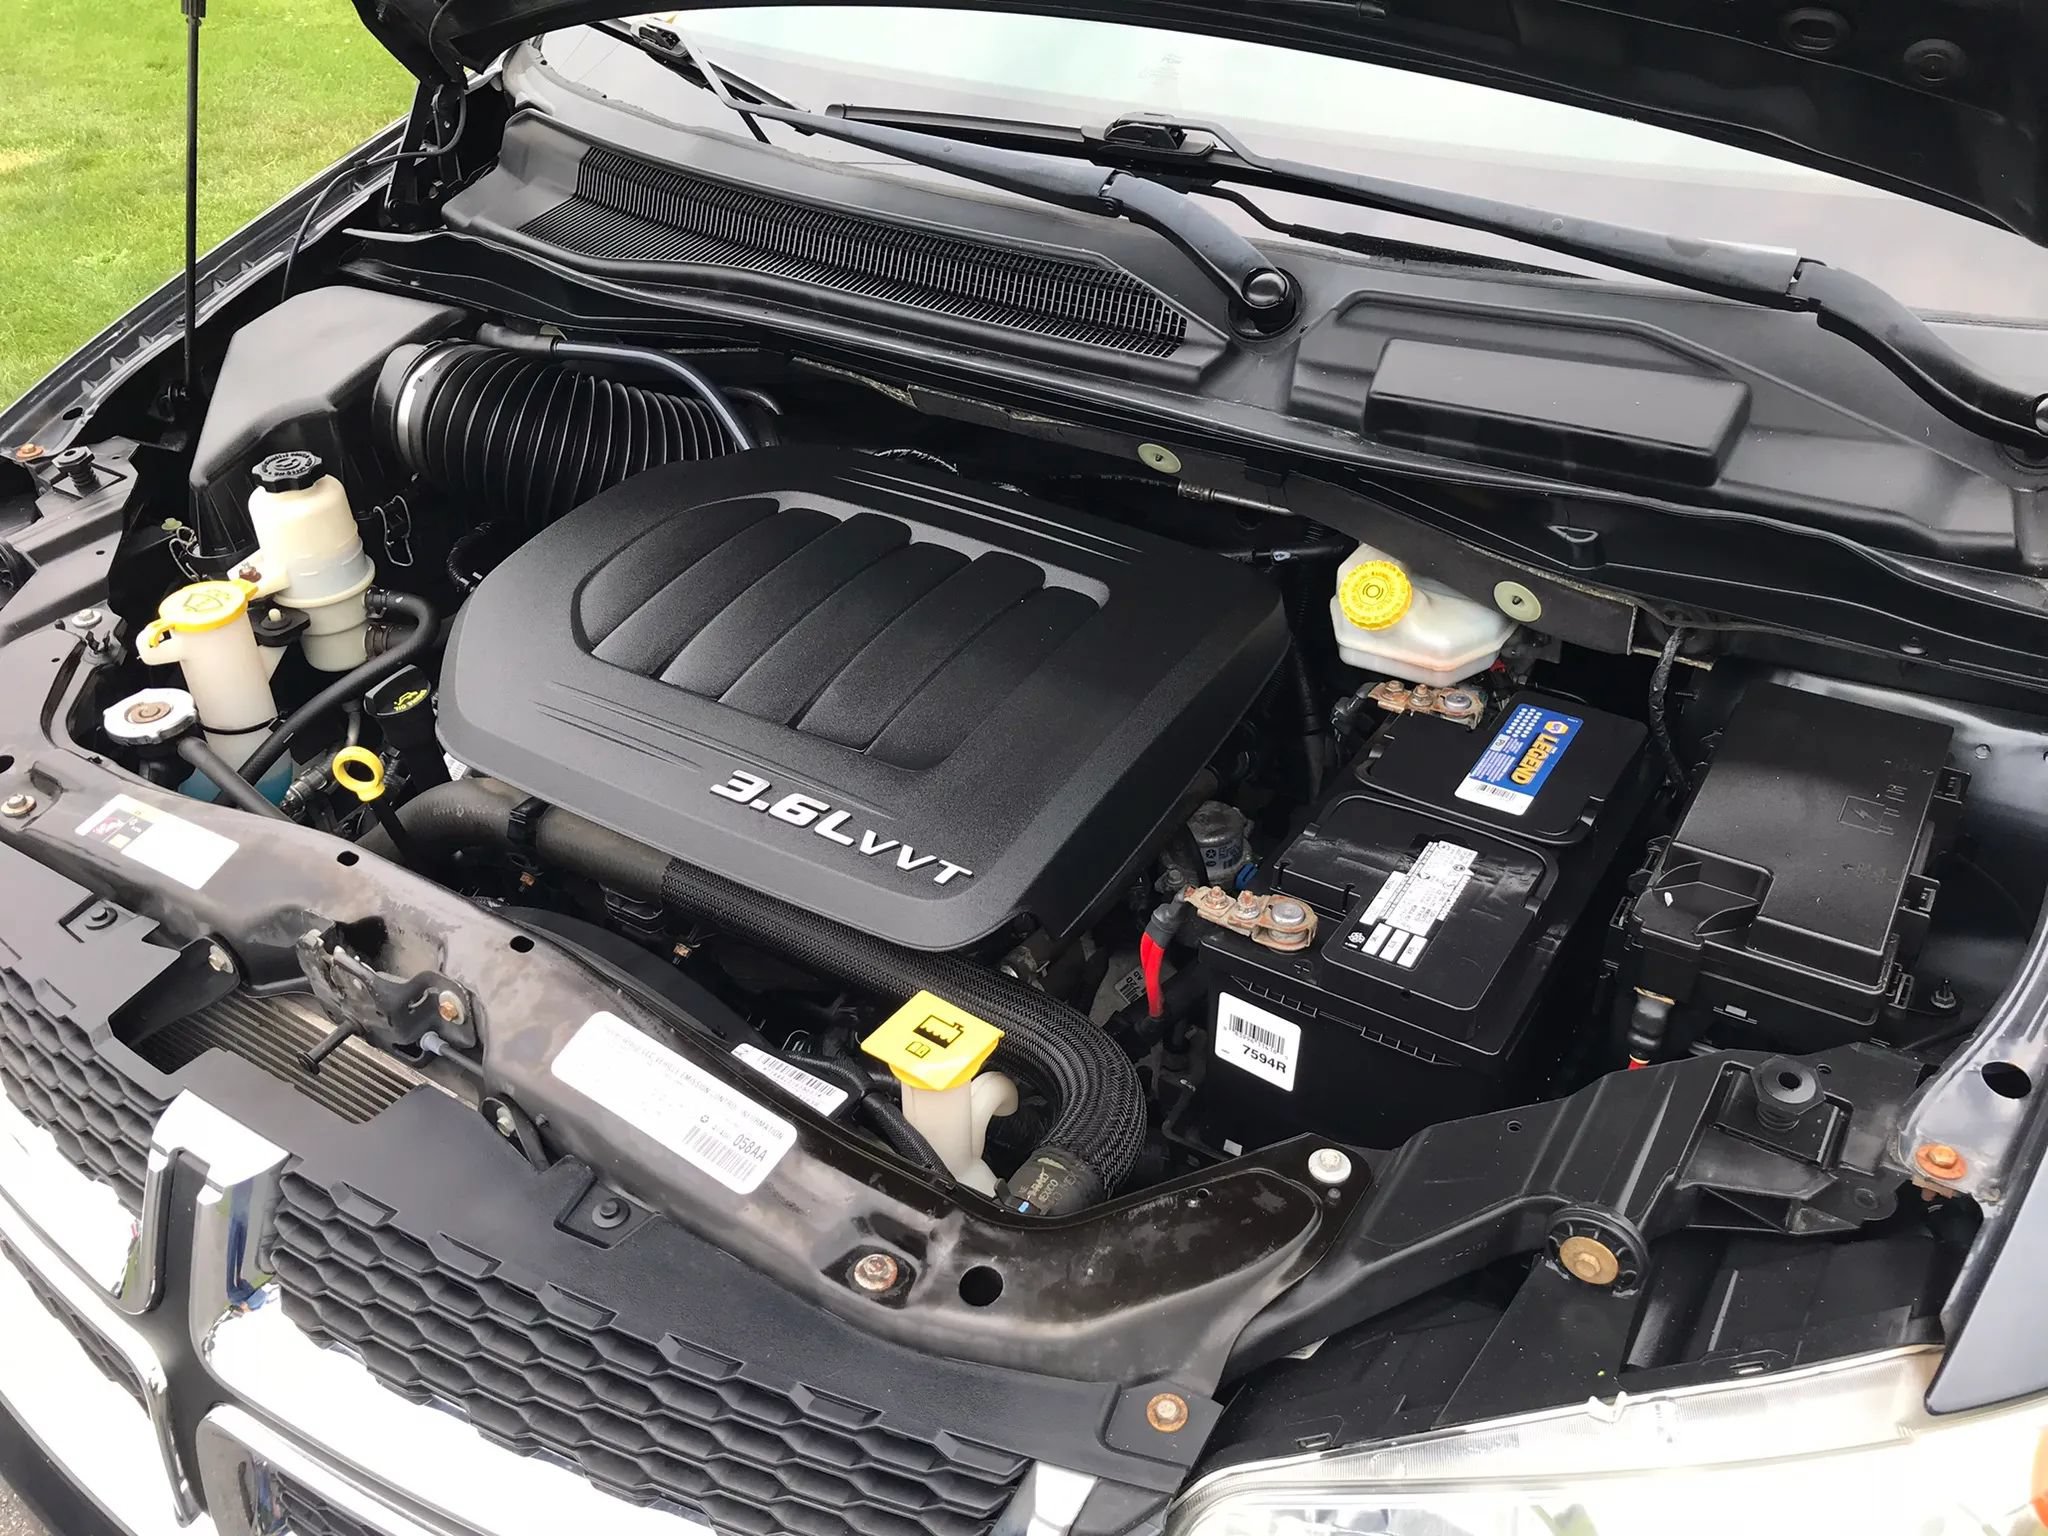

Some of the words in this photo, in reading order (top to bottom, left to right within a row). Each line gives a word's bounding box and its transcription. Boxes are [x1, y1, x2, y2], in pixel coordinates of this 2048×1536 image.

[1511, 733, 1560, 785] LEGEND
[1242, 1044, 1287, 1074] 7594R
[732, 1133, 768, 1162] 058AA
